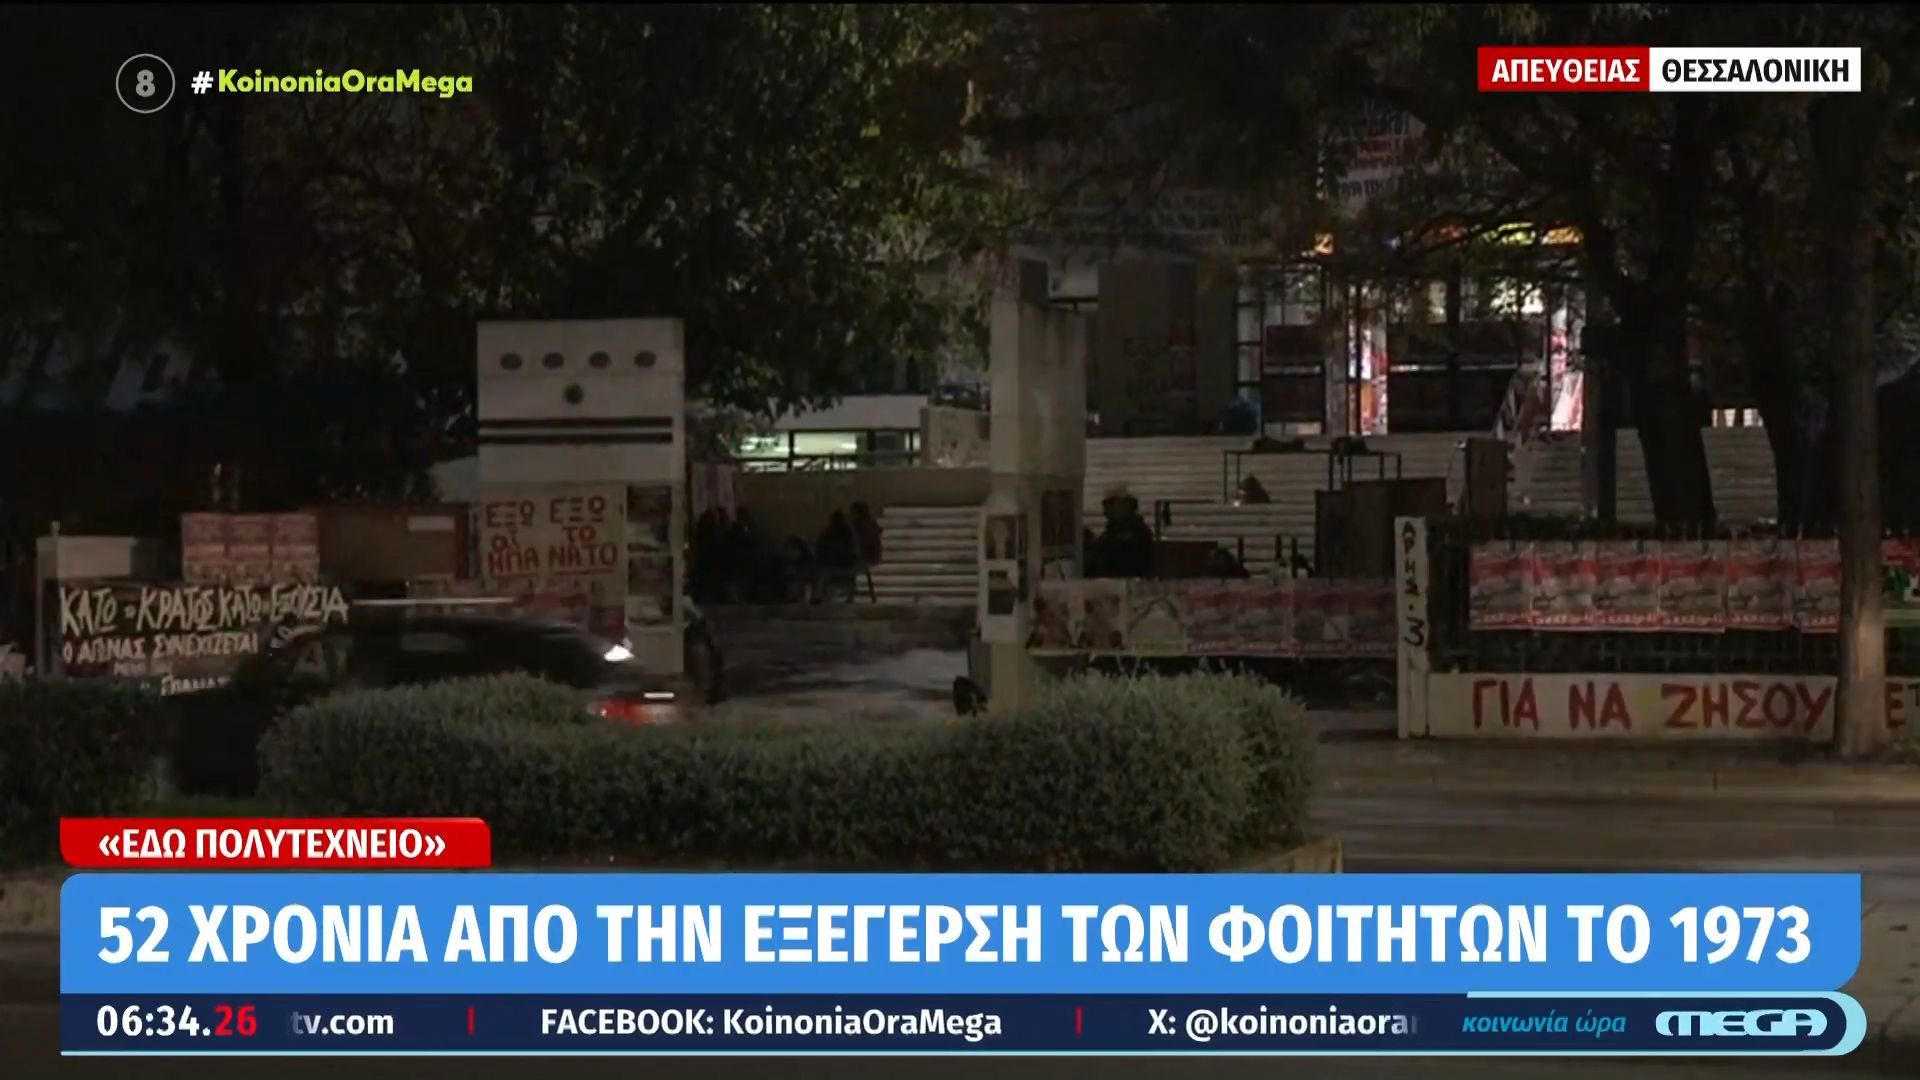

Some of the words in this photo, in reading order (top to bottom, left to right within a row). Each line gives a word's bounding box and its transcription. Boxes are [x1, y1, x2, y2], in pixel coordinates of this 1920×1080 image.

[551, 543, 618, 567] ΝΑΤΟ
[60, 585, 118, 638] ΚΑΤΩ
[1472, 680, 1538, 731] ΓΙΑ
[1569, 681, 1632, 731] ΝΑ
